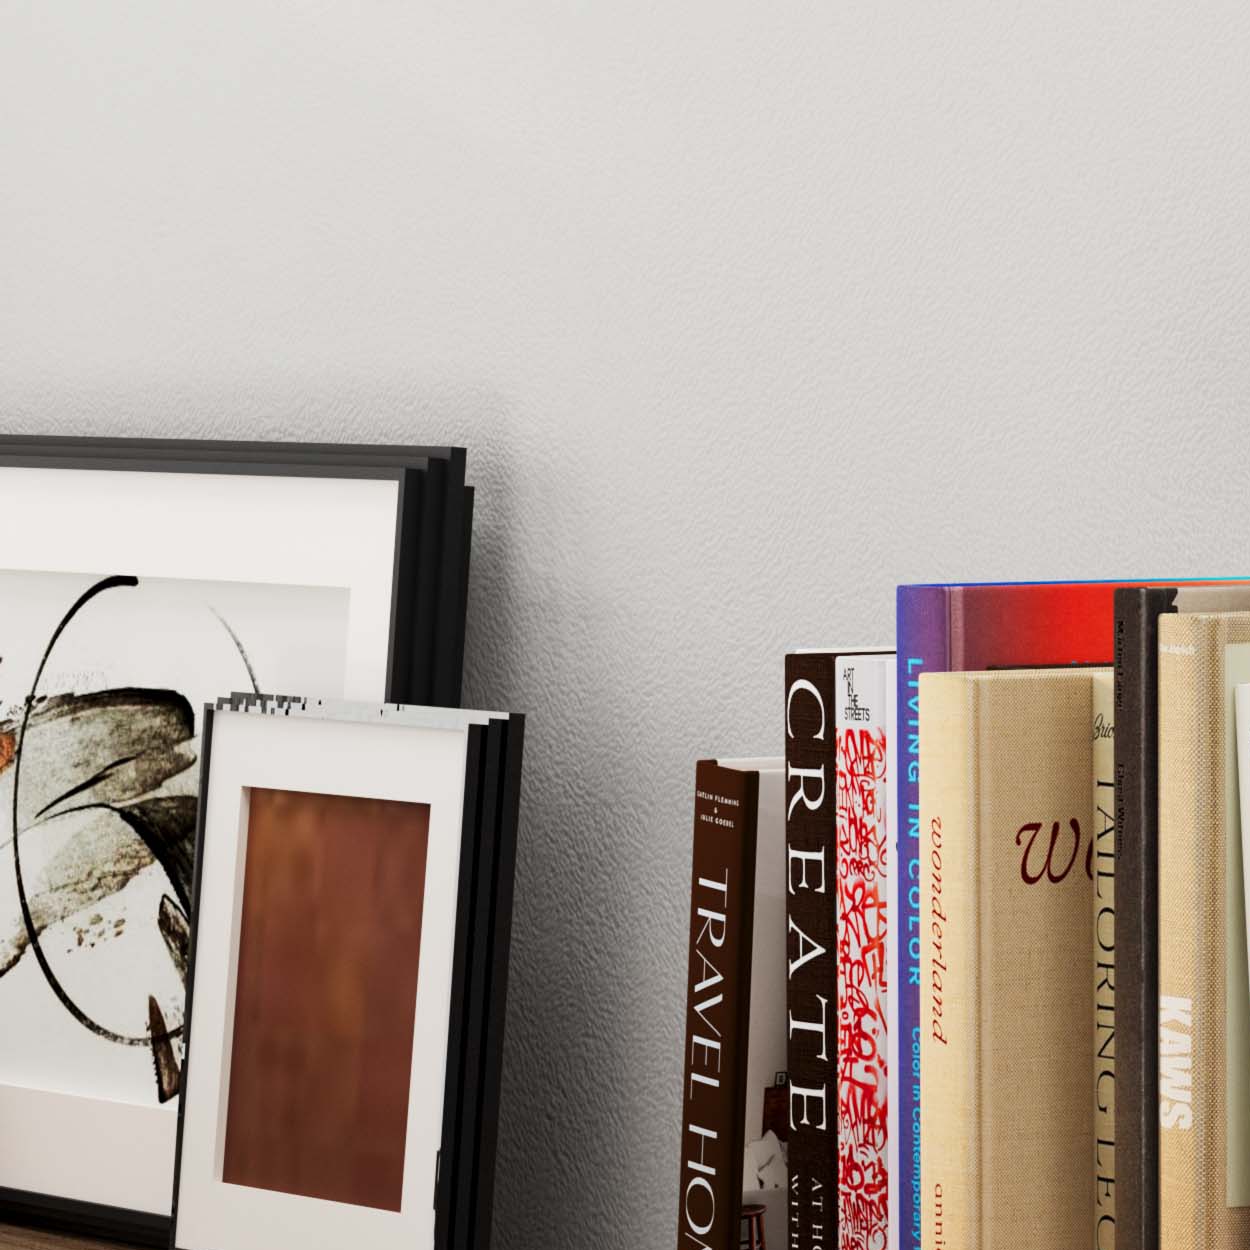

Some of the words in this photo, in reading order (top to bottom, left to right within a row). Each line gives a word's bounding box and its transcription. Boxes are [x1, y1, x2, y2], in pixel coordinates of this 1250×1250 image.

[907, 658, 923, 782] LIVING
[908, 803, 920, 838] IN
[787, 678, 828, 1132] CREATE
[908, 858, 920, 985] COLOR
[932, 816, 948, 1045] wonderland
[690, 868, 728, 1100] TRAVEL
[1159, 995, 1192, 1130] KAWS
[791, 1174, 799, 1249] WITH
[811, 1177, 823, 1212] AT
